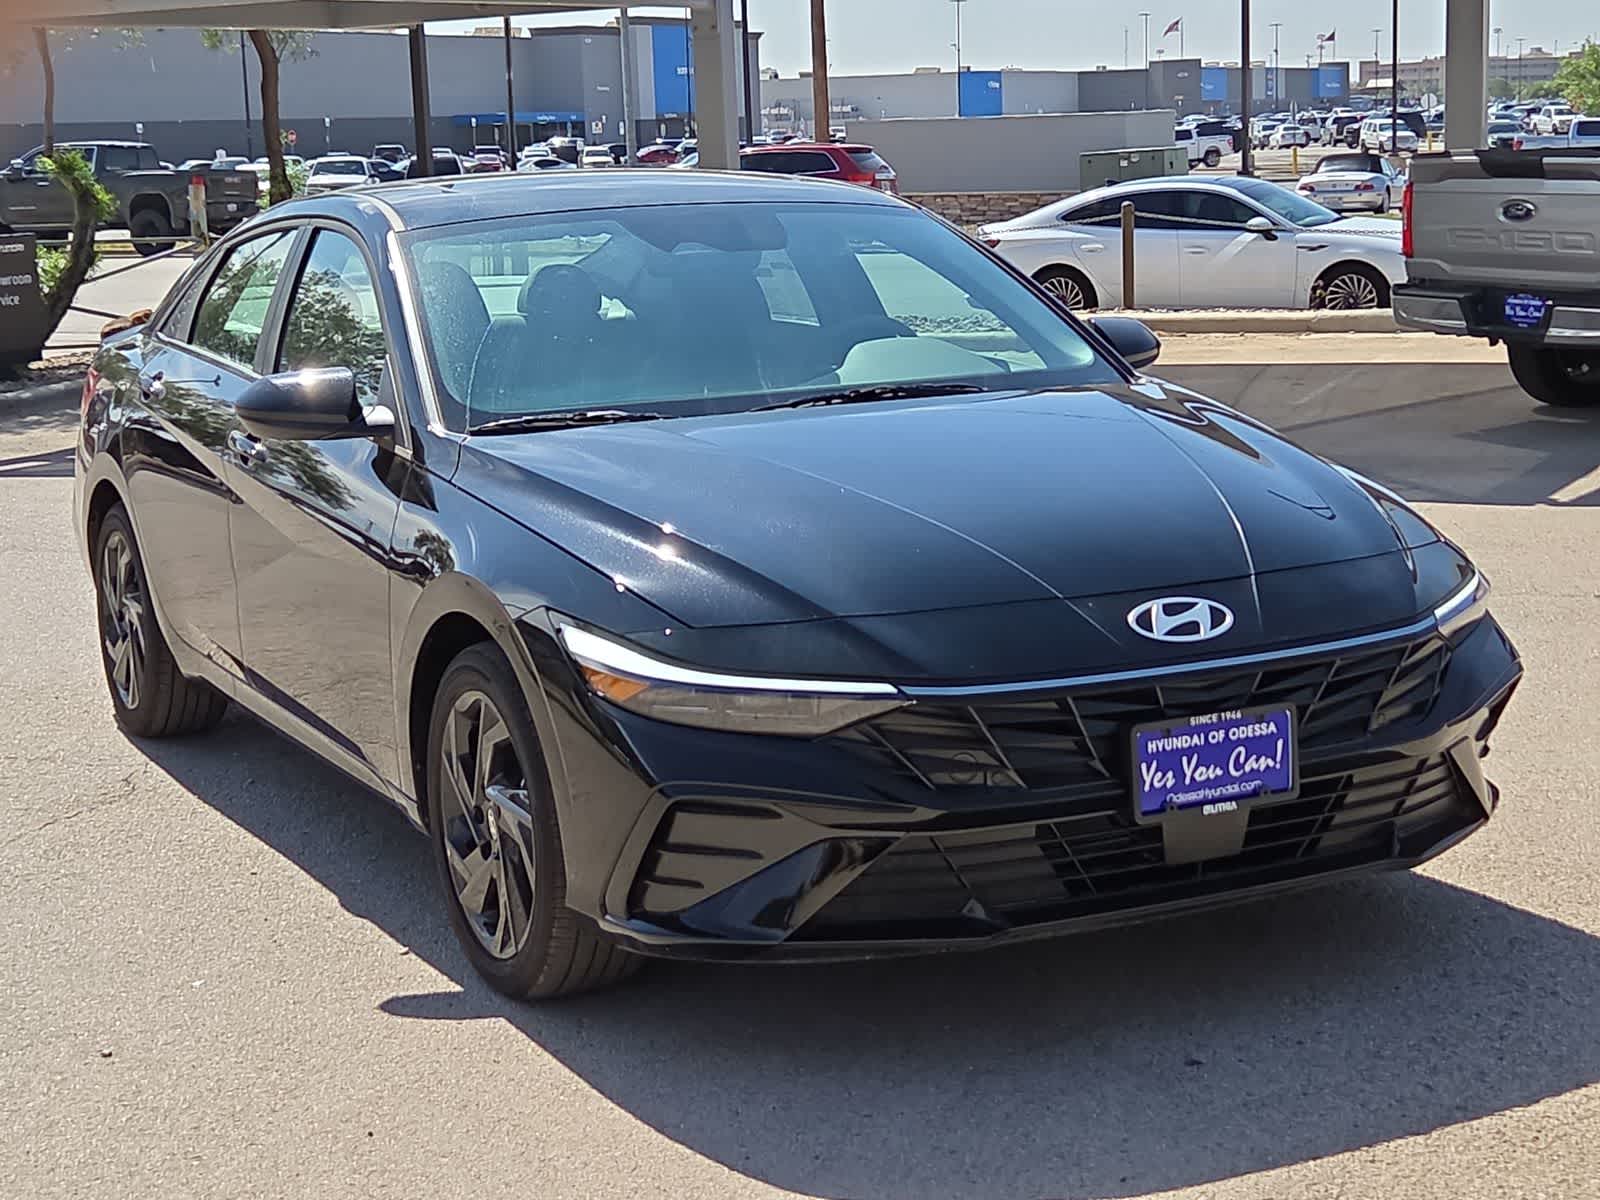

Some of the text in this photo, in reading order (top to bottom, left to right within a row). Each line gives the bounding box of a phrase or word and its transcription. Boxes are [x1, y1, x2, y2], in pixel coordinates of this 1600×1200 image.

[1189, 713, 1218, 726] SINCE
[1147, 721, 1278, 754] HYUNDAI OF ODESSA
[1140, 738, 1284, 793] Yes You Can!
